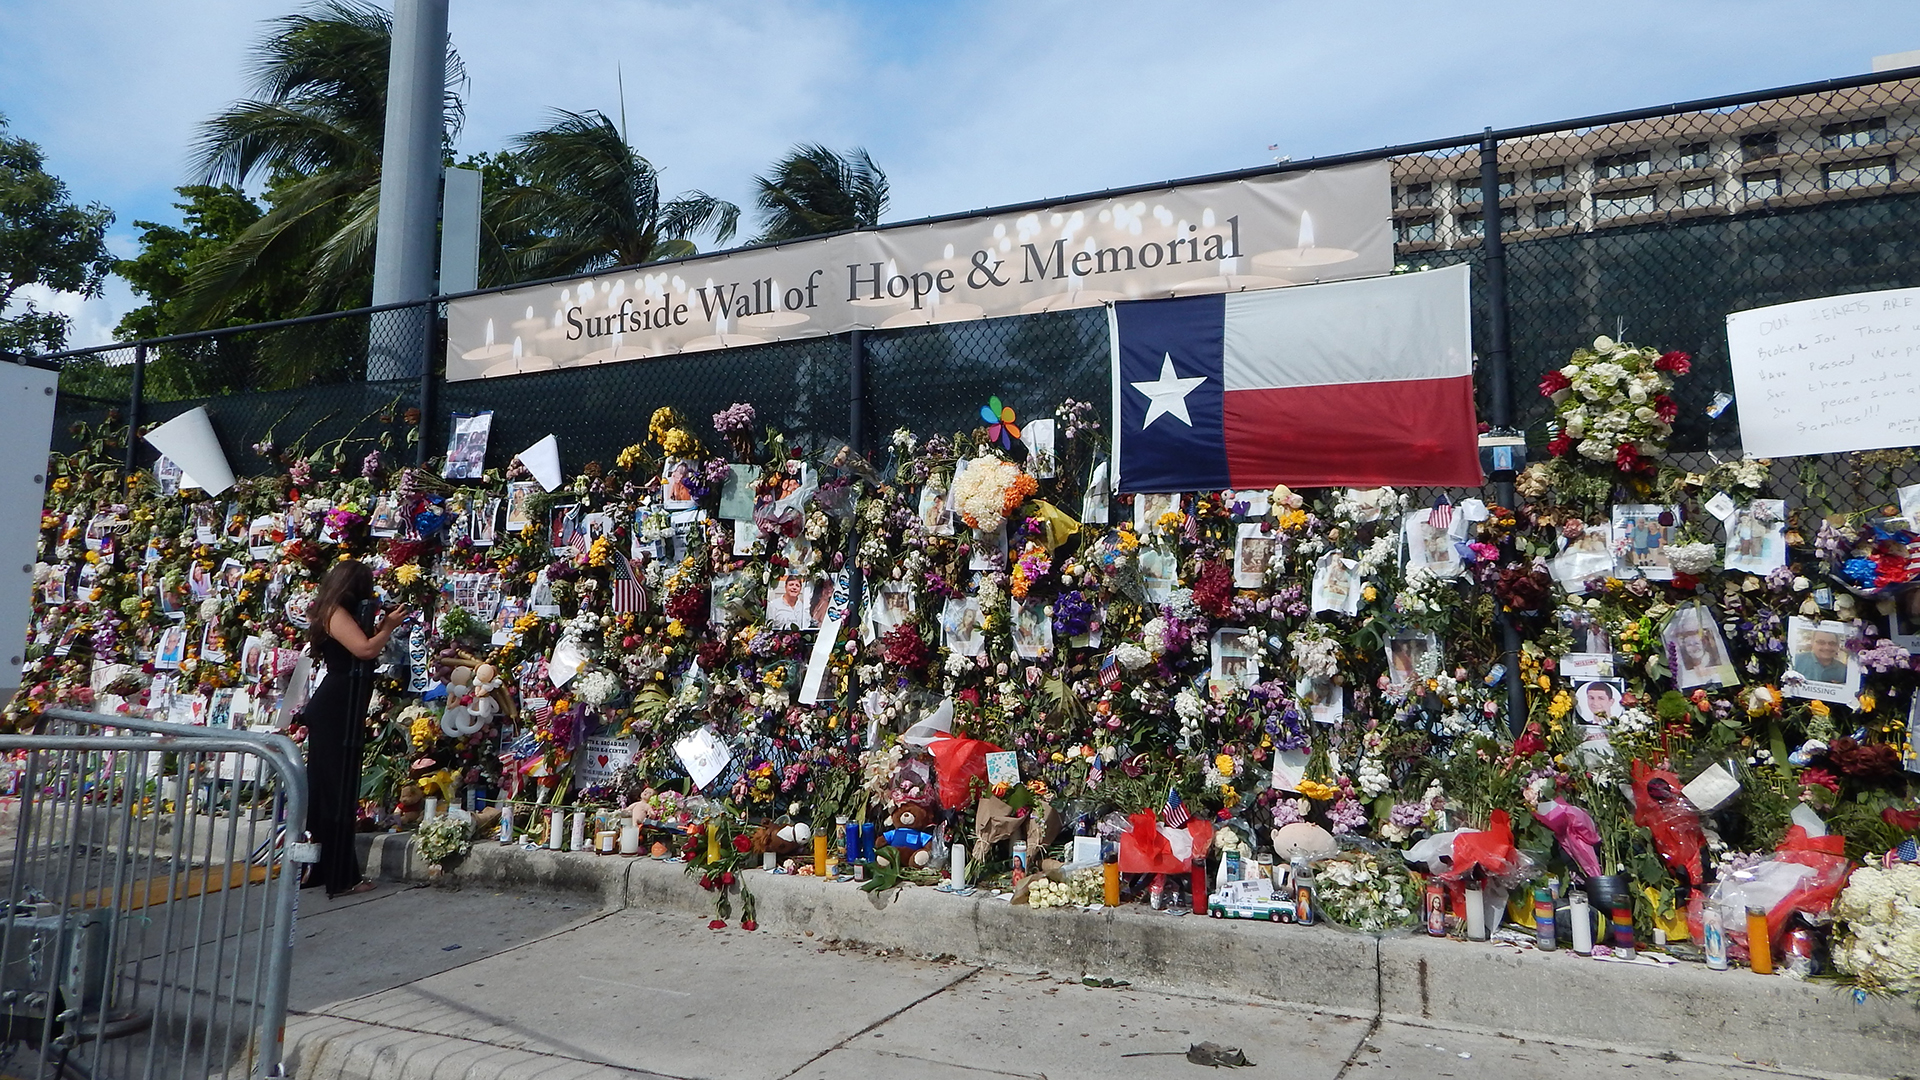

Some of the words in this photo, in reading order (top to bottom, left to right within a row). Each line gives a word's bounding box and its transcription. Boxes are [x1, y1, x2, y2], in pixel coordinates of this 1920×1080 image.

[566, 293, 689, 341] Surfside
[696, 277, 776, 323] Wall
[784, 269, 824, 311] of
[846, 261, 955, 310] Hope
[966, 249, 1010, 290] &
[1019, 215, 1244, 284] Memorial
[1883, 297, 1914, 311] ARE
[1821, 396, 1860, 413] peace
[1801, 685, 1836, 696] MISSING
